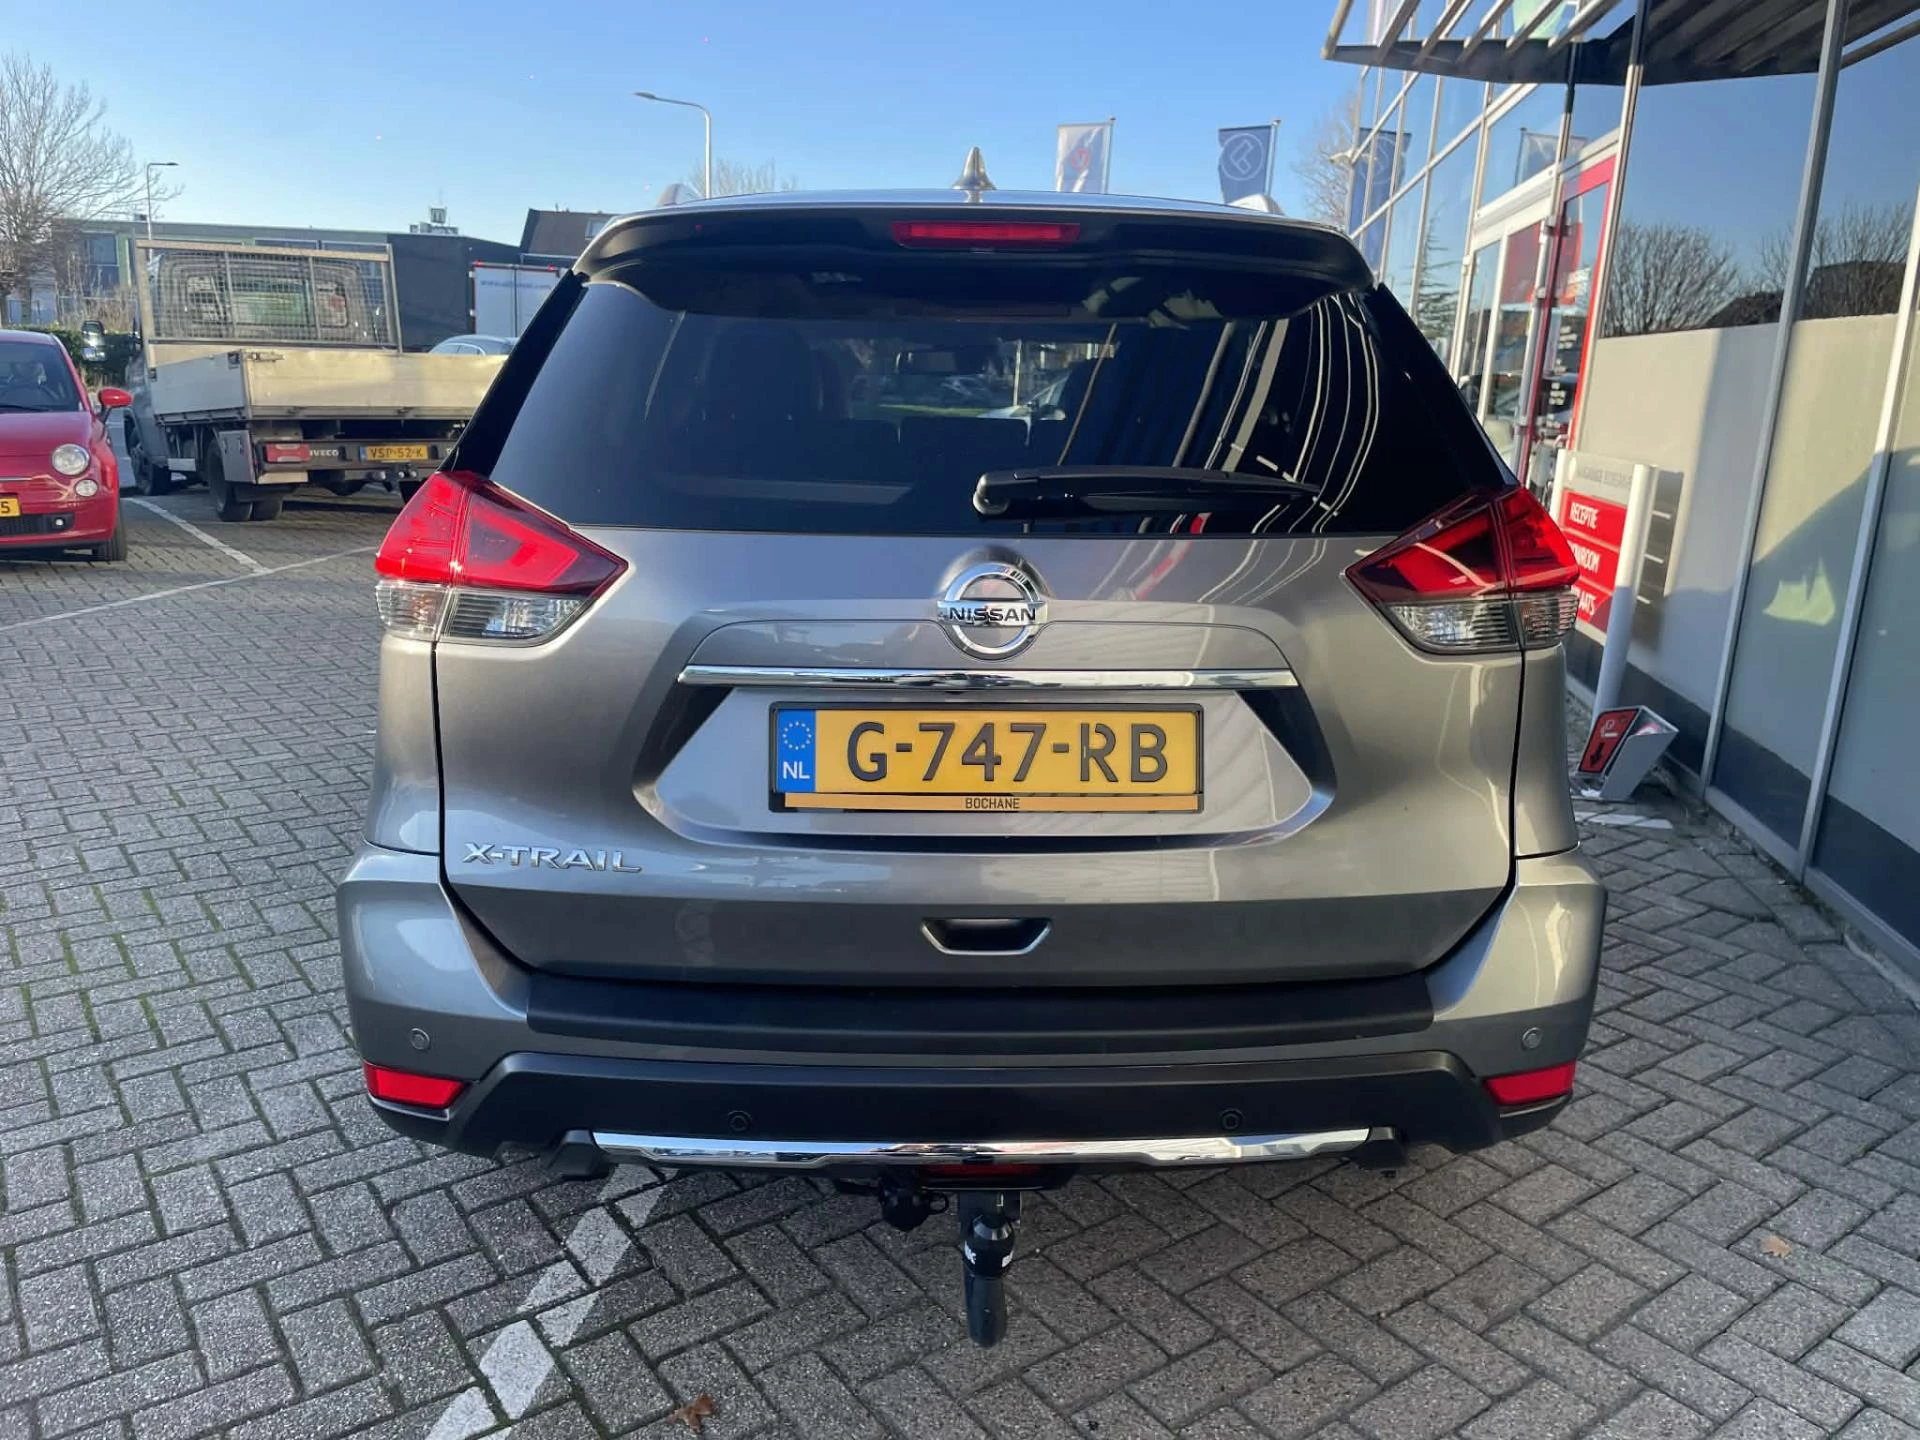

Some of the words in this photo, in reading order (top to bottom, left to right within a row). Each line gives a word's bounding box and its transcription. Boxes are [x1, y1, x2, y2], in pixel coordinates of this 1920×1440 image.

[309, 449, 340, 457] IVECO
[949, 606, 1037, 622] NISSAN
[847, 722, 1168, 783] G-747-RB
[782, 761, 811, 780] NL
[964, 797, 1020, 810] BOCHANE
[463, 842, 642, 874] X-TRAIL
